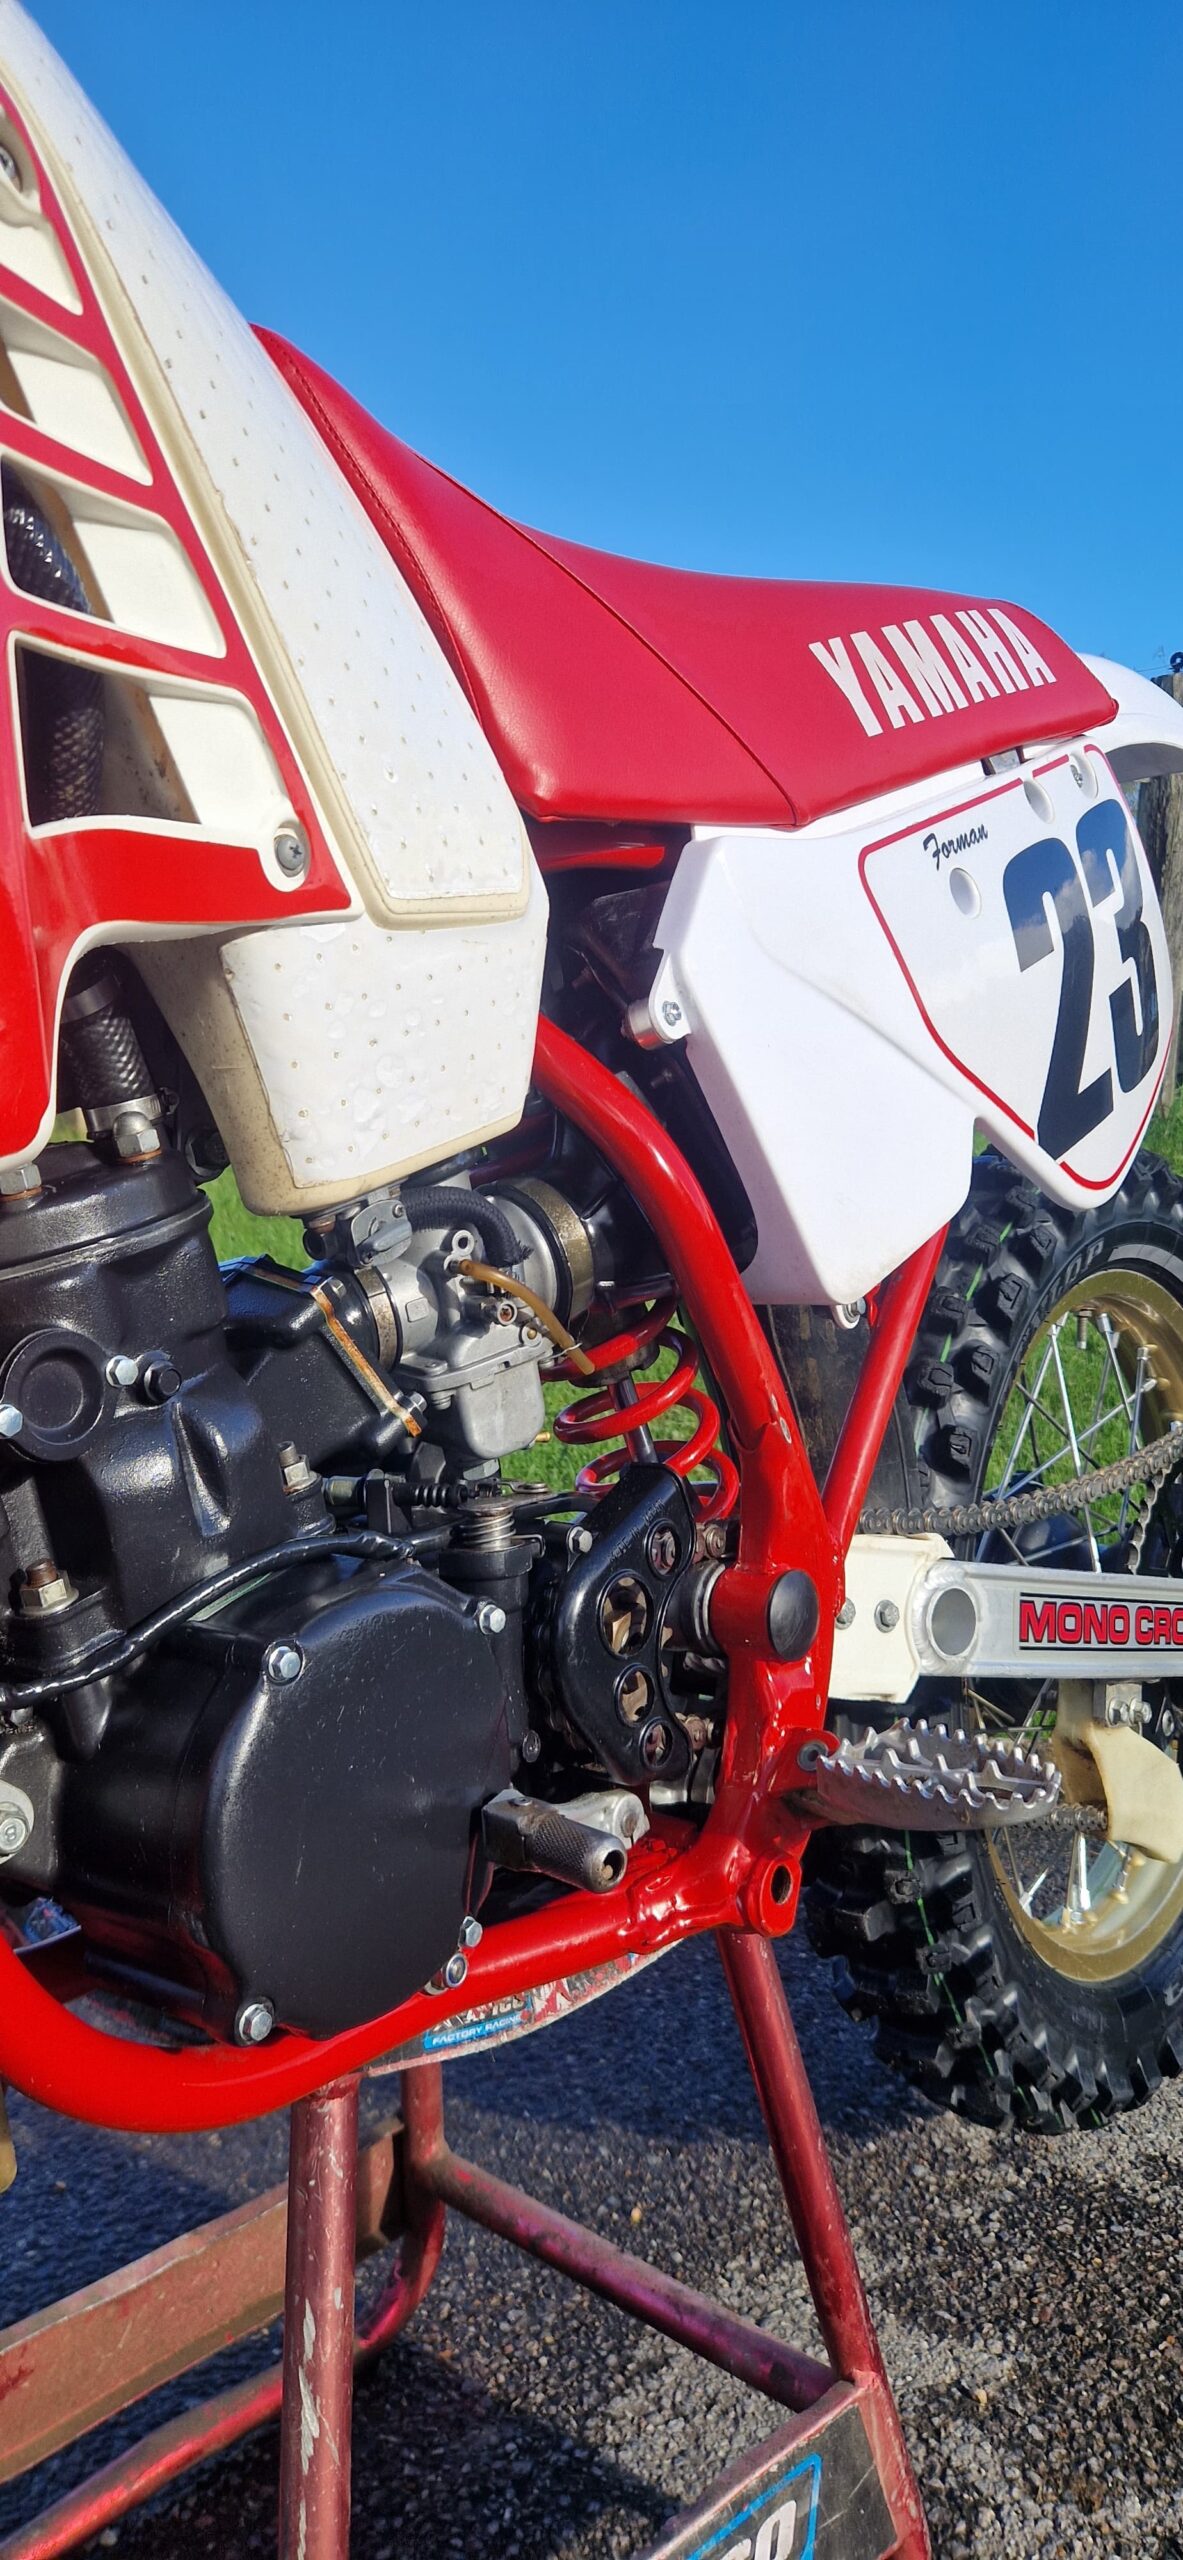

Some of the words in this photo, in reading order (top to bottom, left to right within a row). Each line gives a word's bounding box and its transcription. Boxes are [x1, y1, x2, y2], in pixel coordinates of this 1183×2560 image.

[808, 608, 1057, 737] YAMAHA
[923, 823, 989, 871] Forman
[1003, 798, 1159, 1161] 23
[1019, 1600, 1130, 1645] MONO
[431, 2021, 483, 2046] FACTORY
